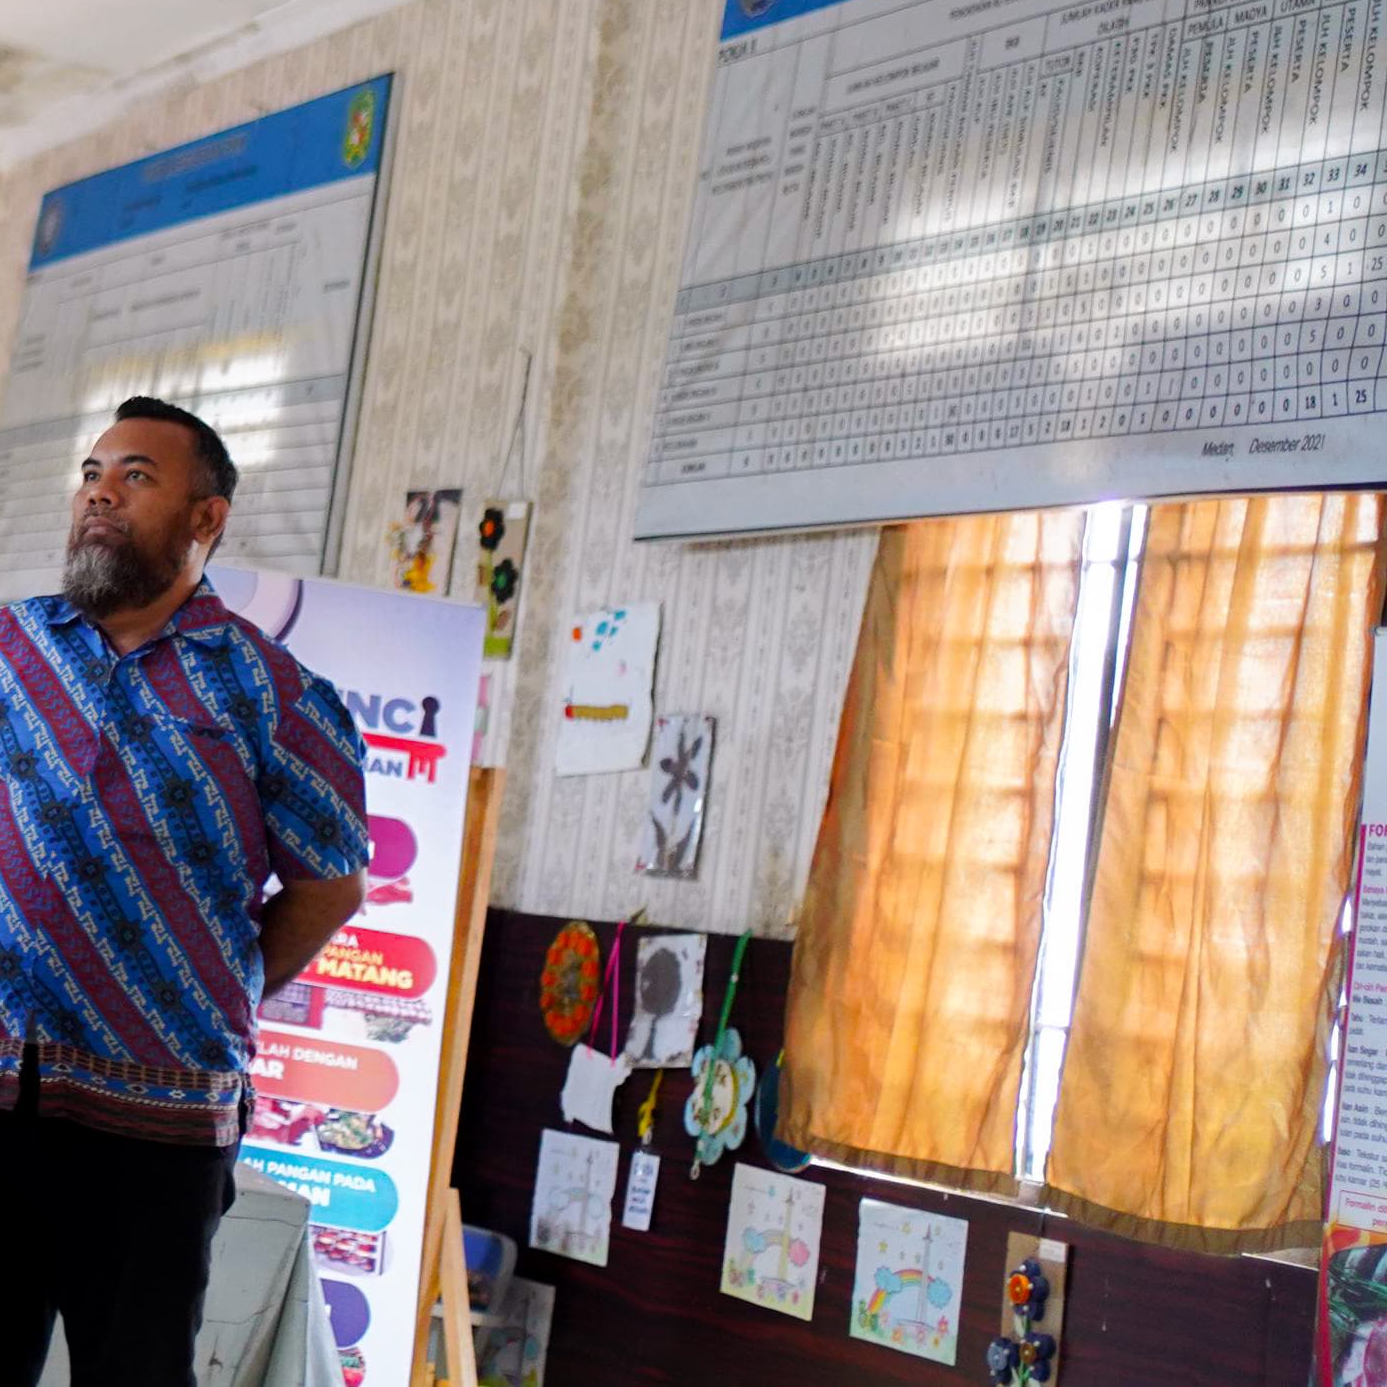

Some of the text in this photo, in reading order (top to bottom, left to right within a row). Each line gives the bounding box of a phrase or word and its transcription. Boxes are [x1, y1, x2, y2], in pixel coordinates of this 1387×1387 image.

[1235, 5, 1267, 23] MADYA
[1291, 19, 1307, 83] PESERTA
[1340, 8, 1356, 73] PESERTA
[1244, 30, 1259, 93] PESERTA
[1308, 14, 1331, 125] JLH KELOMPOK
[1360, 28, 1378, 111] KELOMPOK
[1261, 26, 1283, 134] JLH KELOMPOK
[1215, 61, 1231, 143] KELOMPOK
[1142, 202, 1154, 216] 25
[1163, 198, 1175, 212] 26
[1185, 193, 1198, 207] 27
[1208, 189, 1220, 203] 28
[1231, 185, 1244, 199] 29
[1255, 181, 1267, 196] 30
[1277, 177, 1290, 192] 31
[1303, 172, 1315, 186] 32
[1327, 167, 1340, 182] 33
[1354, 163, 1368, 177] 34
[1230, 195, 1361, 230] 0 0 0 0 1 0
[1225, 223, 1386, 261] 0 0 0 0 4 0 0
[1221, 256, 1384, 292] 0 0 0 0 5 1 25
[1217, 310, 1225, 326] 0
[1263, 304, 1272, 318] 0
[1288, 301, 1297, 317] 0
[1314, 297, 1322, 312] 3
[1343, 294, 1351, 308] 0
[1371, 290, 1378, 304] 0
[1216, 323, 1375, 356] 0 0 0 0 5 0 0
[1214, 355, 1369, 387] 0 0 0 0 0 0 0
[1209, 389, 1367, 418] 0 0 0 0 18 1 25
[1249, 436, 1300, 454] Desember
[1301, 433, 1326, 451] 2021
[316, 957, 413, 989] MATANG
[292, 1046, 359, 1070] DENGAN
[267, 1161, 332, 1184] PANGAN
[333, 1173, 376, 1193] PADA
